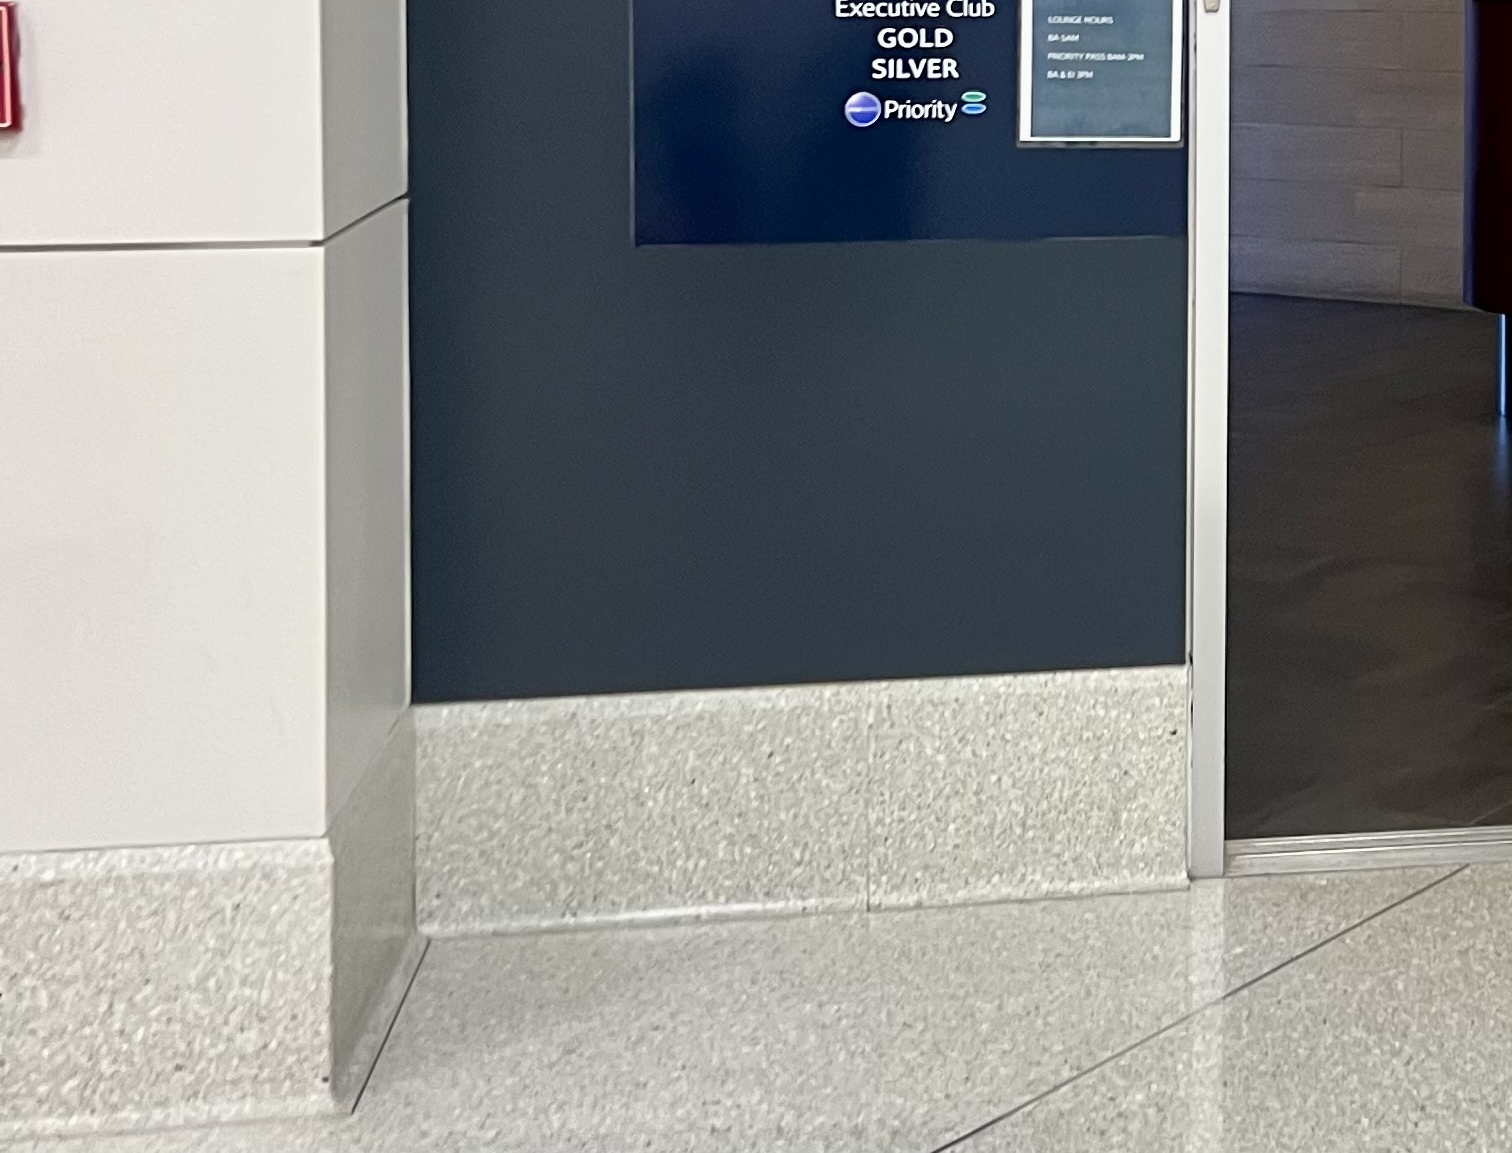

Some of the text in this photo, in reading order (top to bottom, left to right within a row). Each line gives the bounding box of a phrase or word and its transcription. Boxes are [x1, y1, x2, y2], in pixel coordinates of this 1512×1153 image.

[1047, 15, 1083, 24] LOUNGE
[877, 27, 954, 49] GOLD
[871, 58, 960, 79] SILVER
[883, 99, 958, 123] Priority
